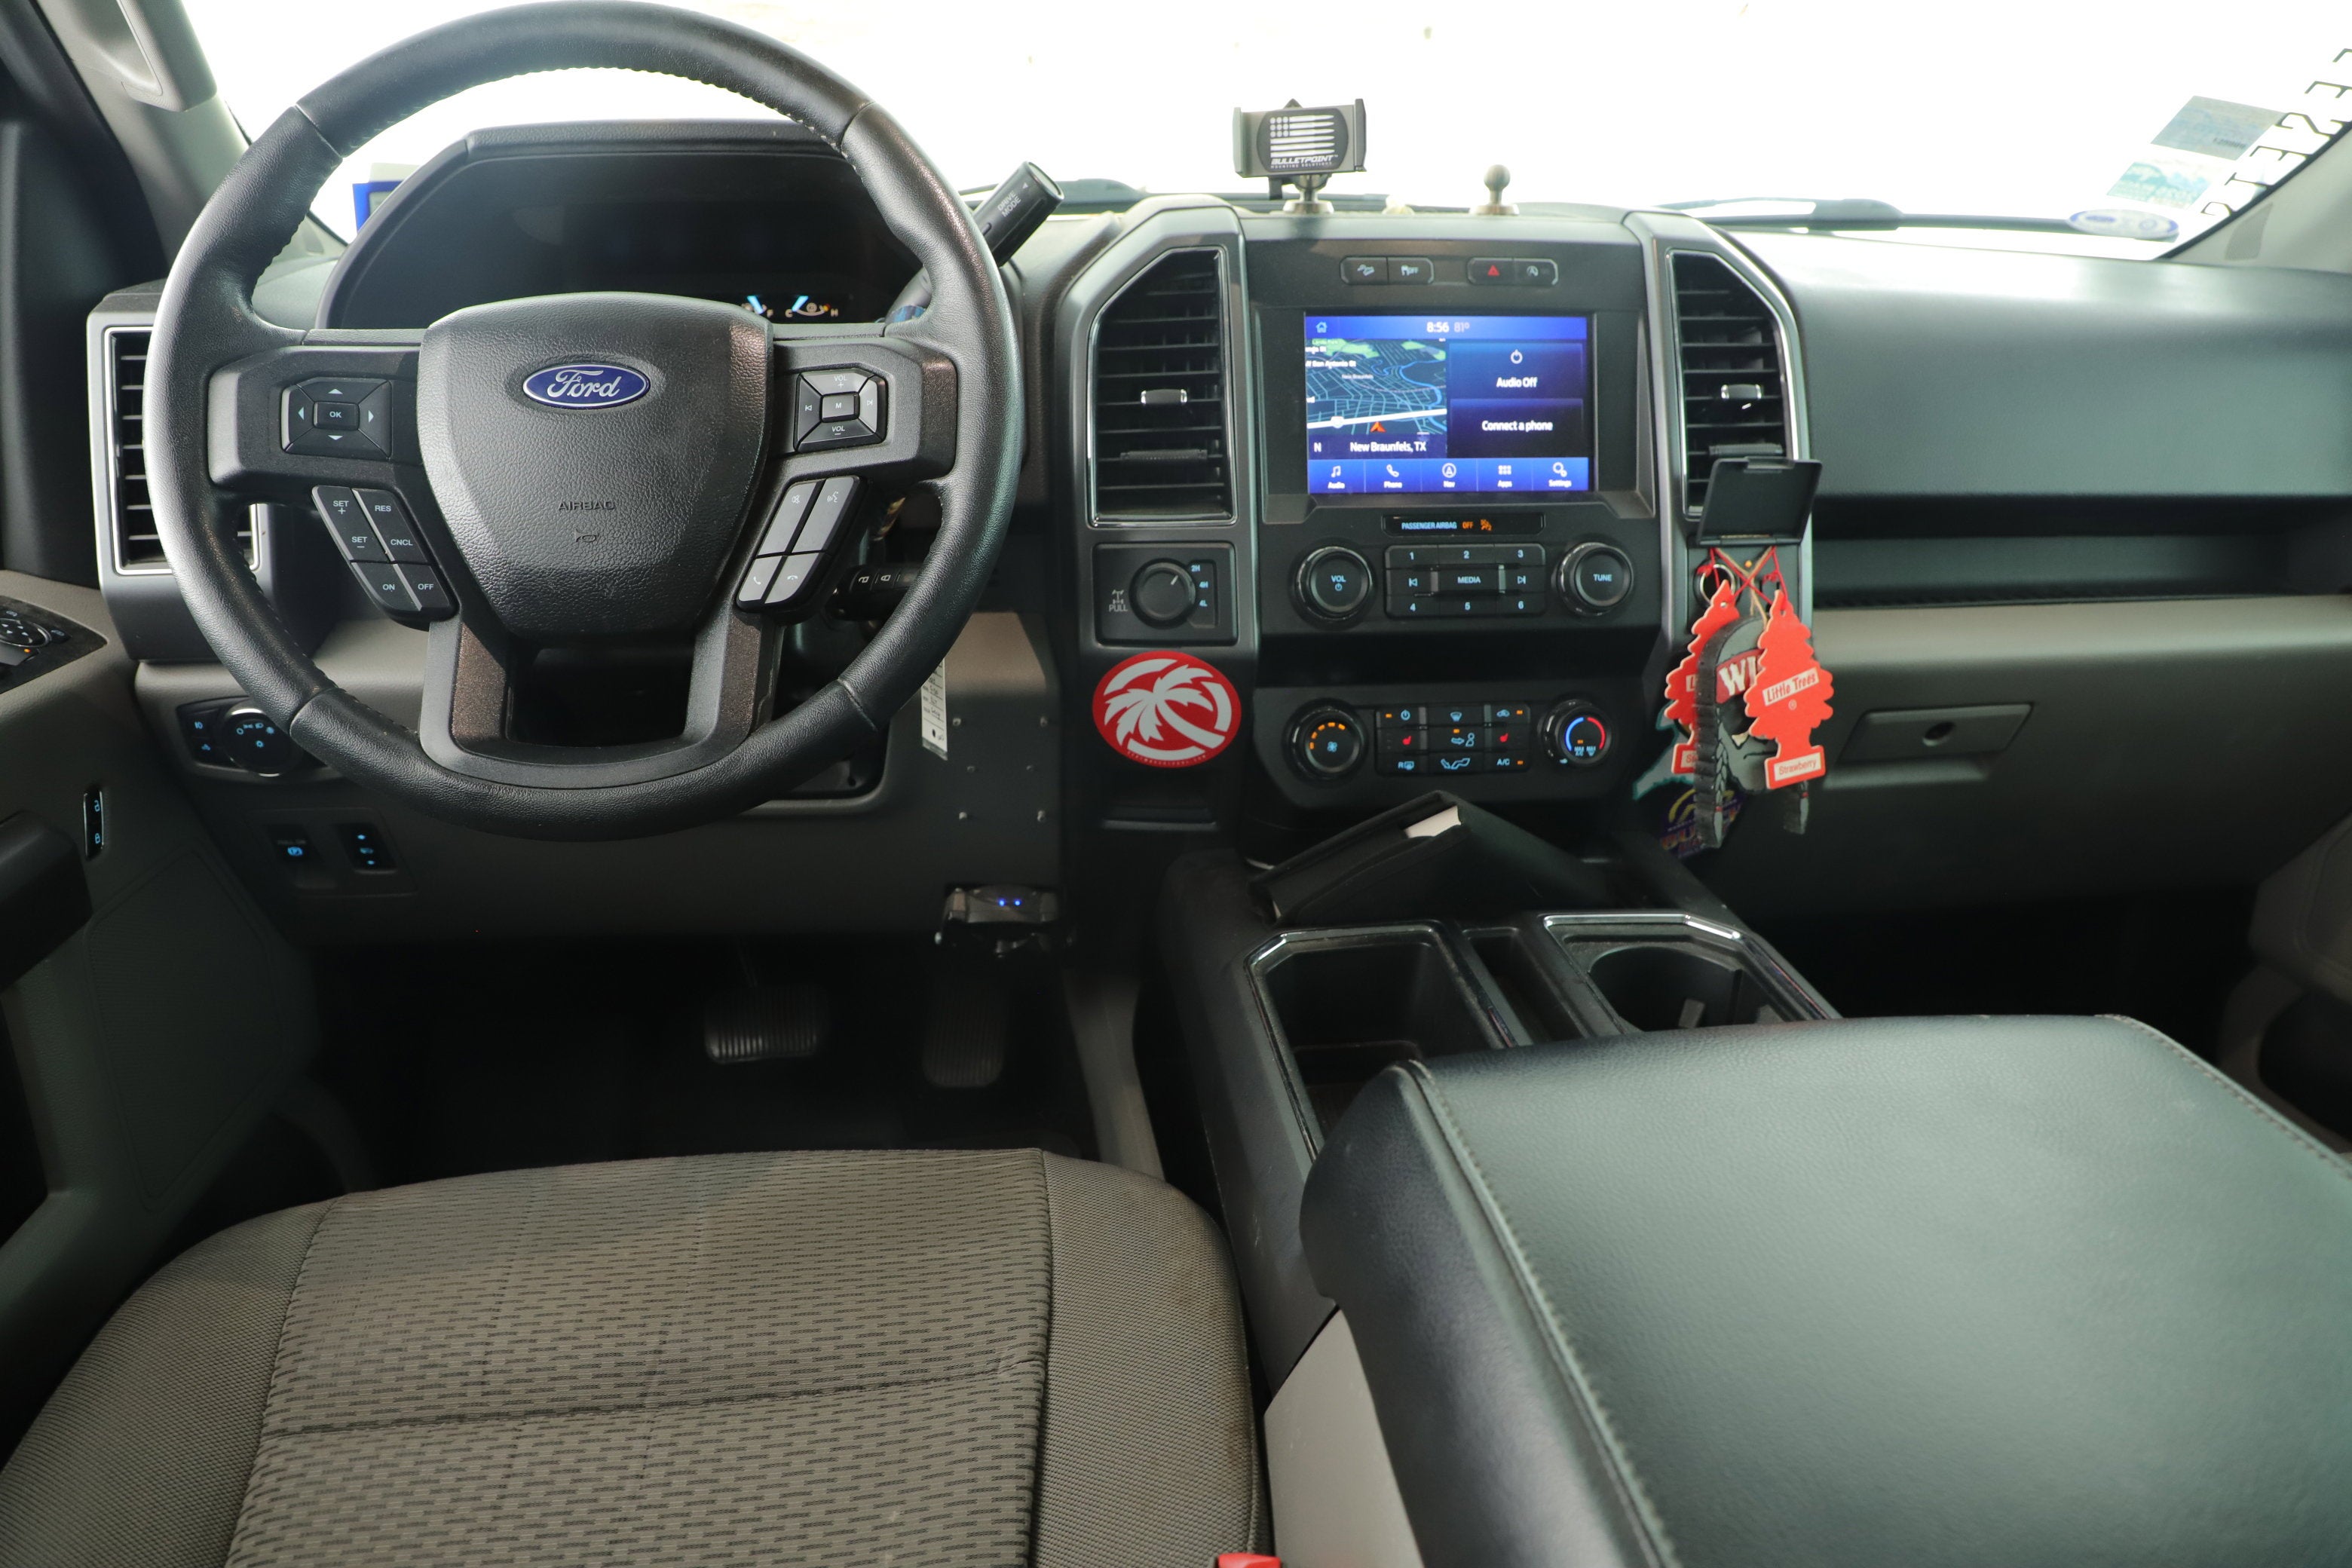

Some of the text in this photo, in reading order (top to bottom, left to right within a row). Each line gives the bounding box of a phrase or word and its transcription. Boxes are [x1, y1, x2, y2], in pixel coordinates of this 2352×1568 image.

[1271, 155, 1334, 164] BULLETPOINT
[997, 190, 1016, 211] DRIVE
[1001, 196, 1021, 217] MODE
[1426, 321, 1450, 333] 8:56
[547, 369, 622, 397] Ford
[1496, 377, 1539, 388] Audio Off
[1481, 420, 1554, 433] Connect a phone
[1314, 442, 1322, 452] N
[1349, 442, 1427, 452] New Braunfels, TX
[1548, 479, 1573, 488] Settings
[1401, 521, 1474, 530] PASSENGER AIRBAG OFF
[1463, 550, 1470, 559] 2
[1517, 550, 1524, 559] 3
[1457, 576, 1481, 584] MEDIA
[1108, 604, 1128, 612] PULL
[1410, 603, 1416, 611] 4
[1464, 602, 1471, 611] 5
[1517, 600, 1524, 609] 6
[1766, 672, 1817, 701] Little Trees
[1778, 759, 1817, 776] Strawberry
